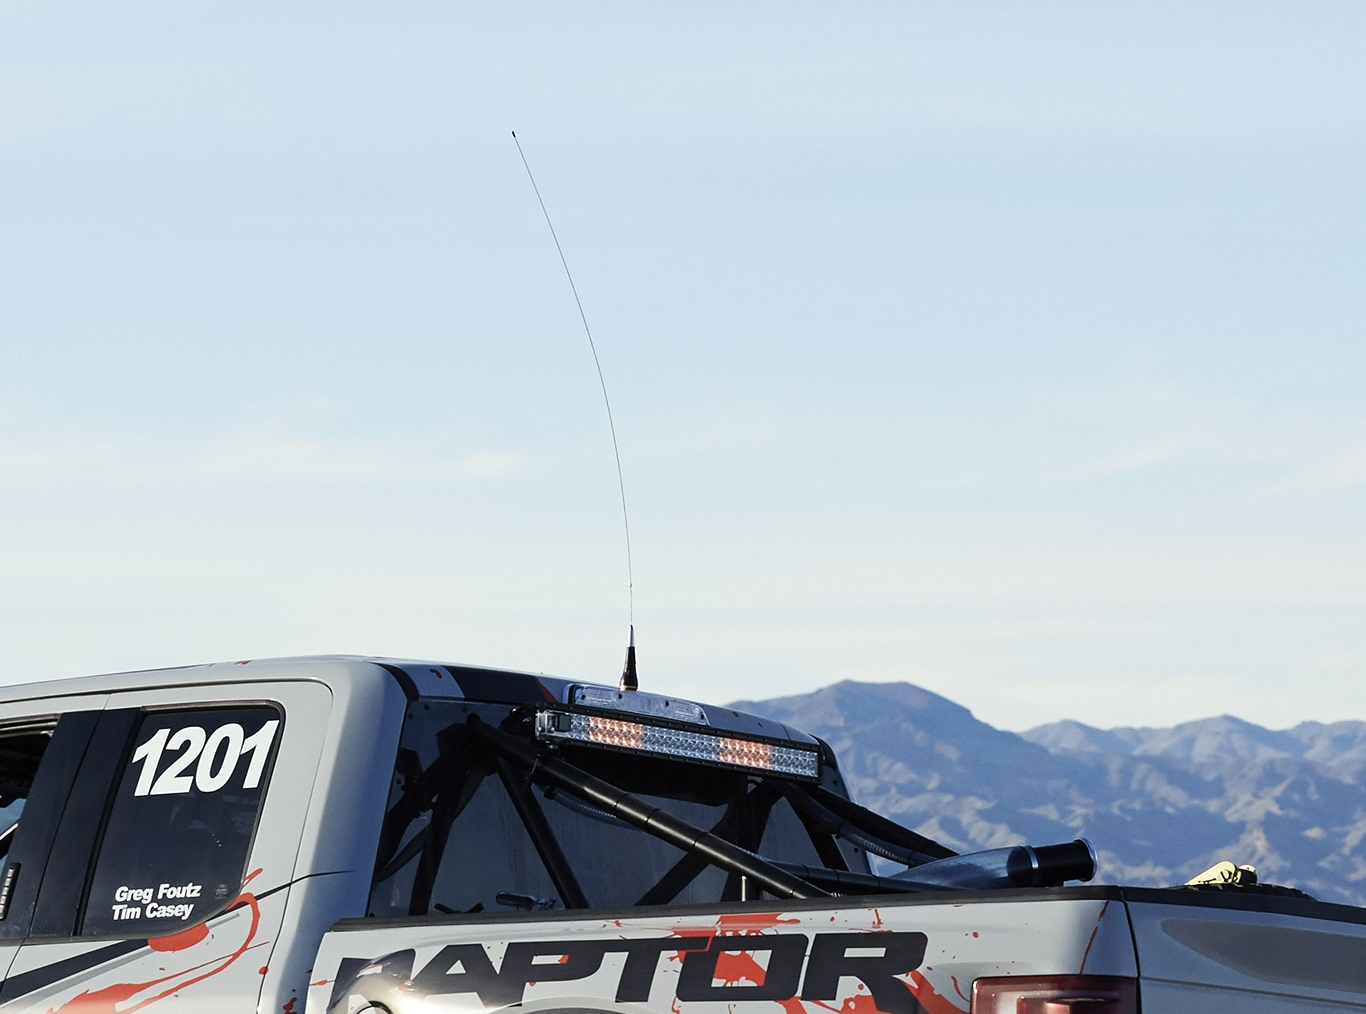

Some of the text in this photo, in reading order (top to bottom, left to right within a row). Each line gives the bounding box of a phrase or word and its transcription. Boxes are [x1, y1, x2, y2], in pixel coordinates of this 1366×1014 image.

[132, 720, 280, 797] 1201
[115, 886, 153, 903] Greg
[157, 883, 202, 899] Foutz
[112, 901, 194, 920] Tim Casey
